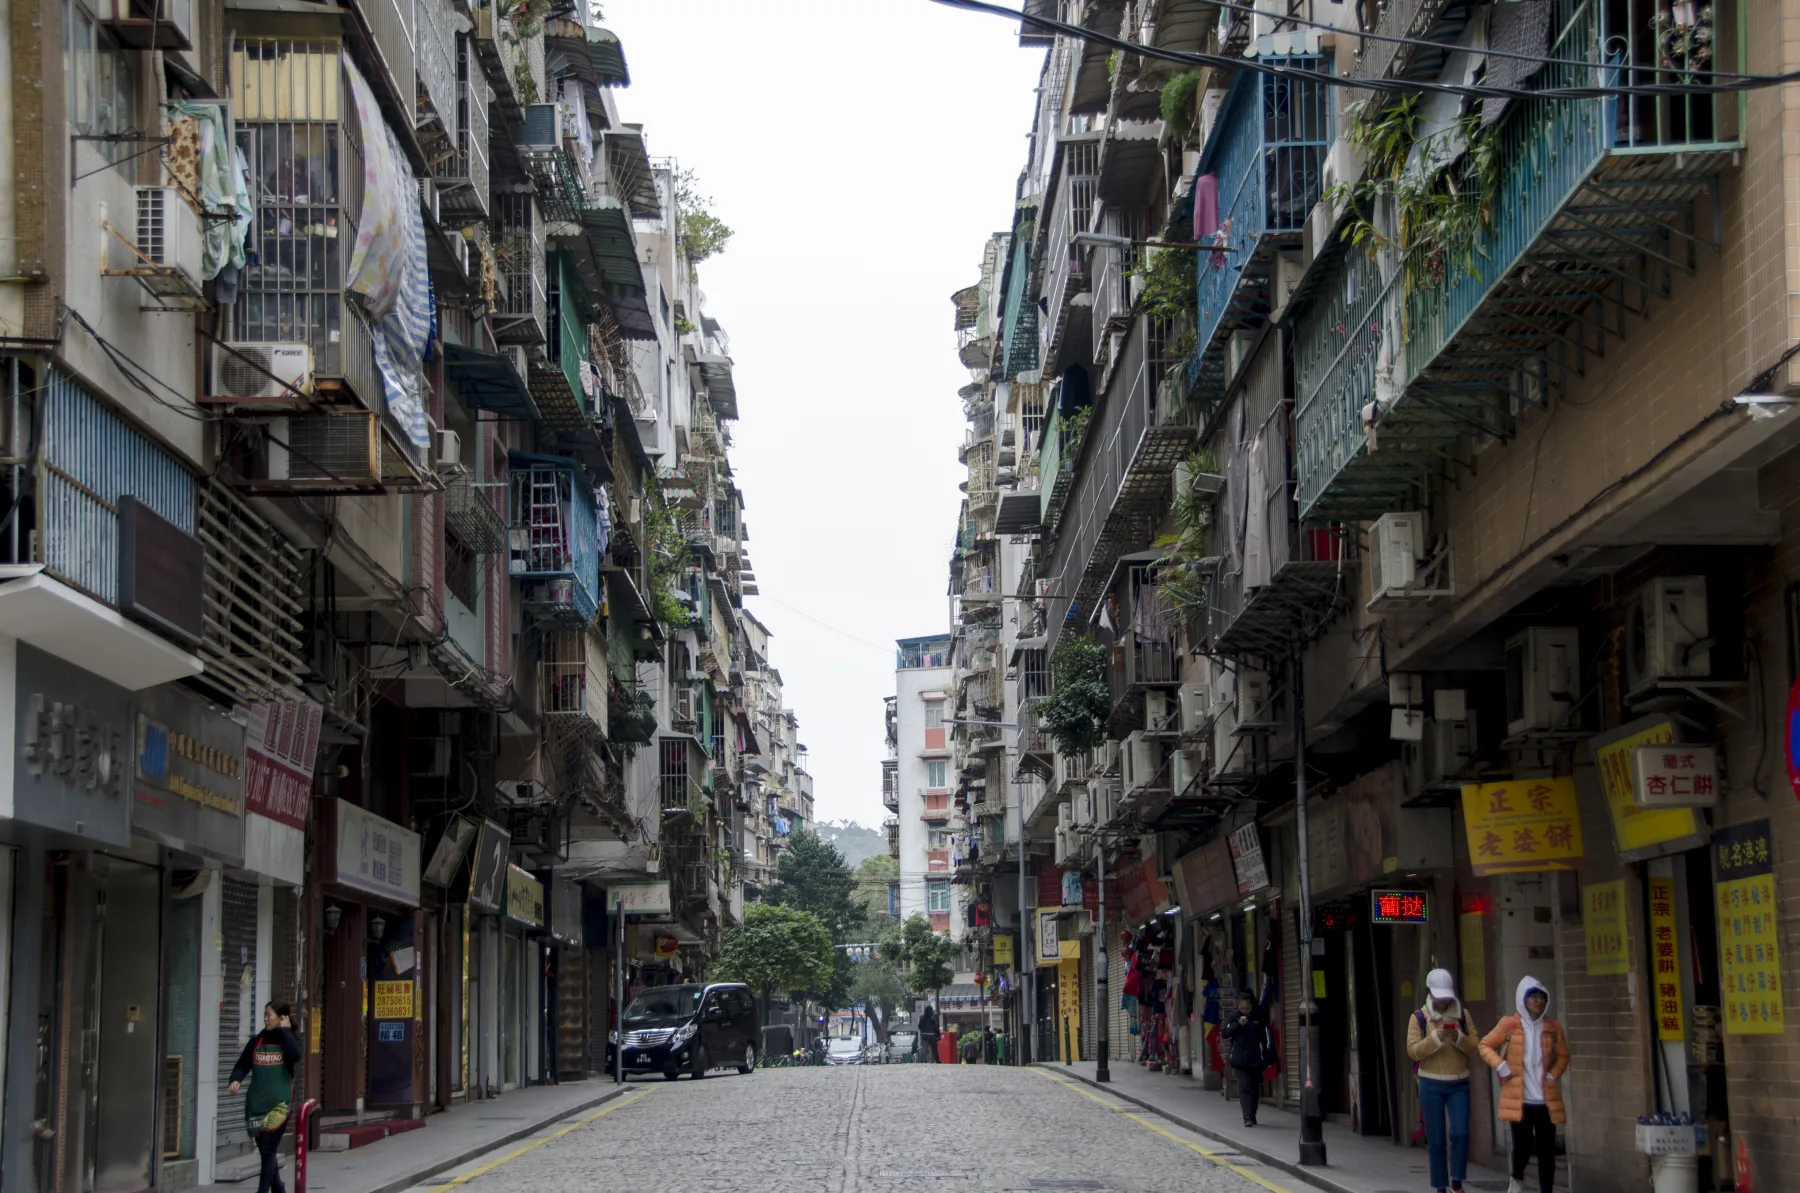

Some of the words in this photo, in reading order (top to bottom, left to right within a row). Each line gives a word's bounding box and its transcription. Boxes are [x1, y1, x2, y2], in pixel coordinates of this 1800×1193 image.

[1662, 754, 1695, 770] 葡式
[1489, 784, 1553, 814] 正宗
[1646, 774, 1713, 796] 杏仁餅
[1478, 824, 1573, 856] 老婆餅
[1652, 885, 1670, 917] 正宗
[1655, 926, 1674, 974] 老婆餅
[377, 995, 411, 1006] 28750615
[1659, 983, 1680, 1032] 豬油糕
[255, 1053, 282, 1061] TSINGTAO
